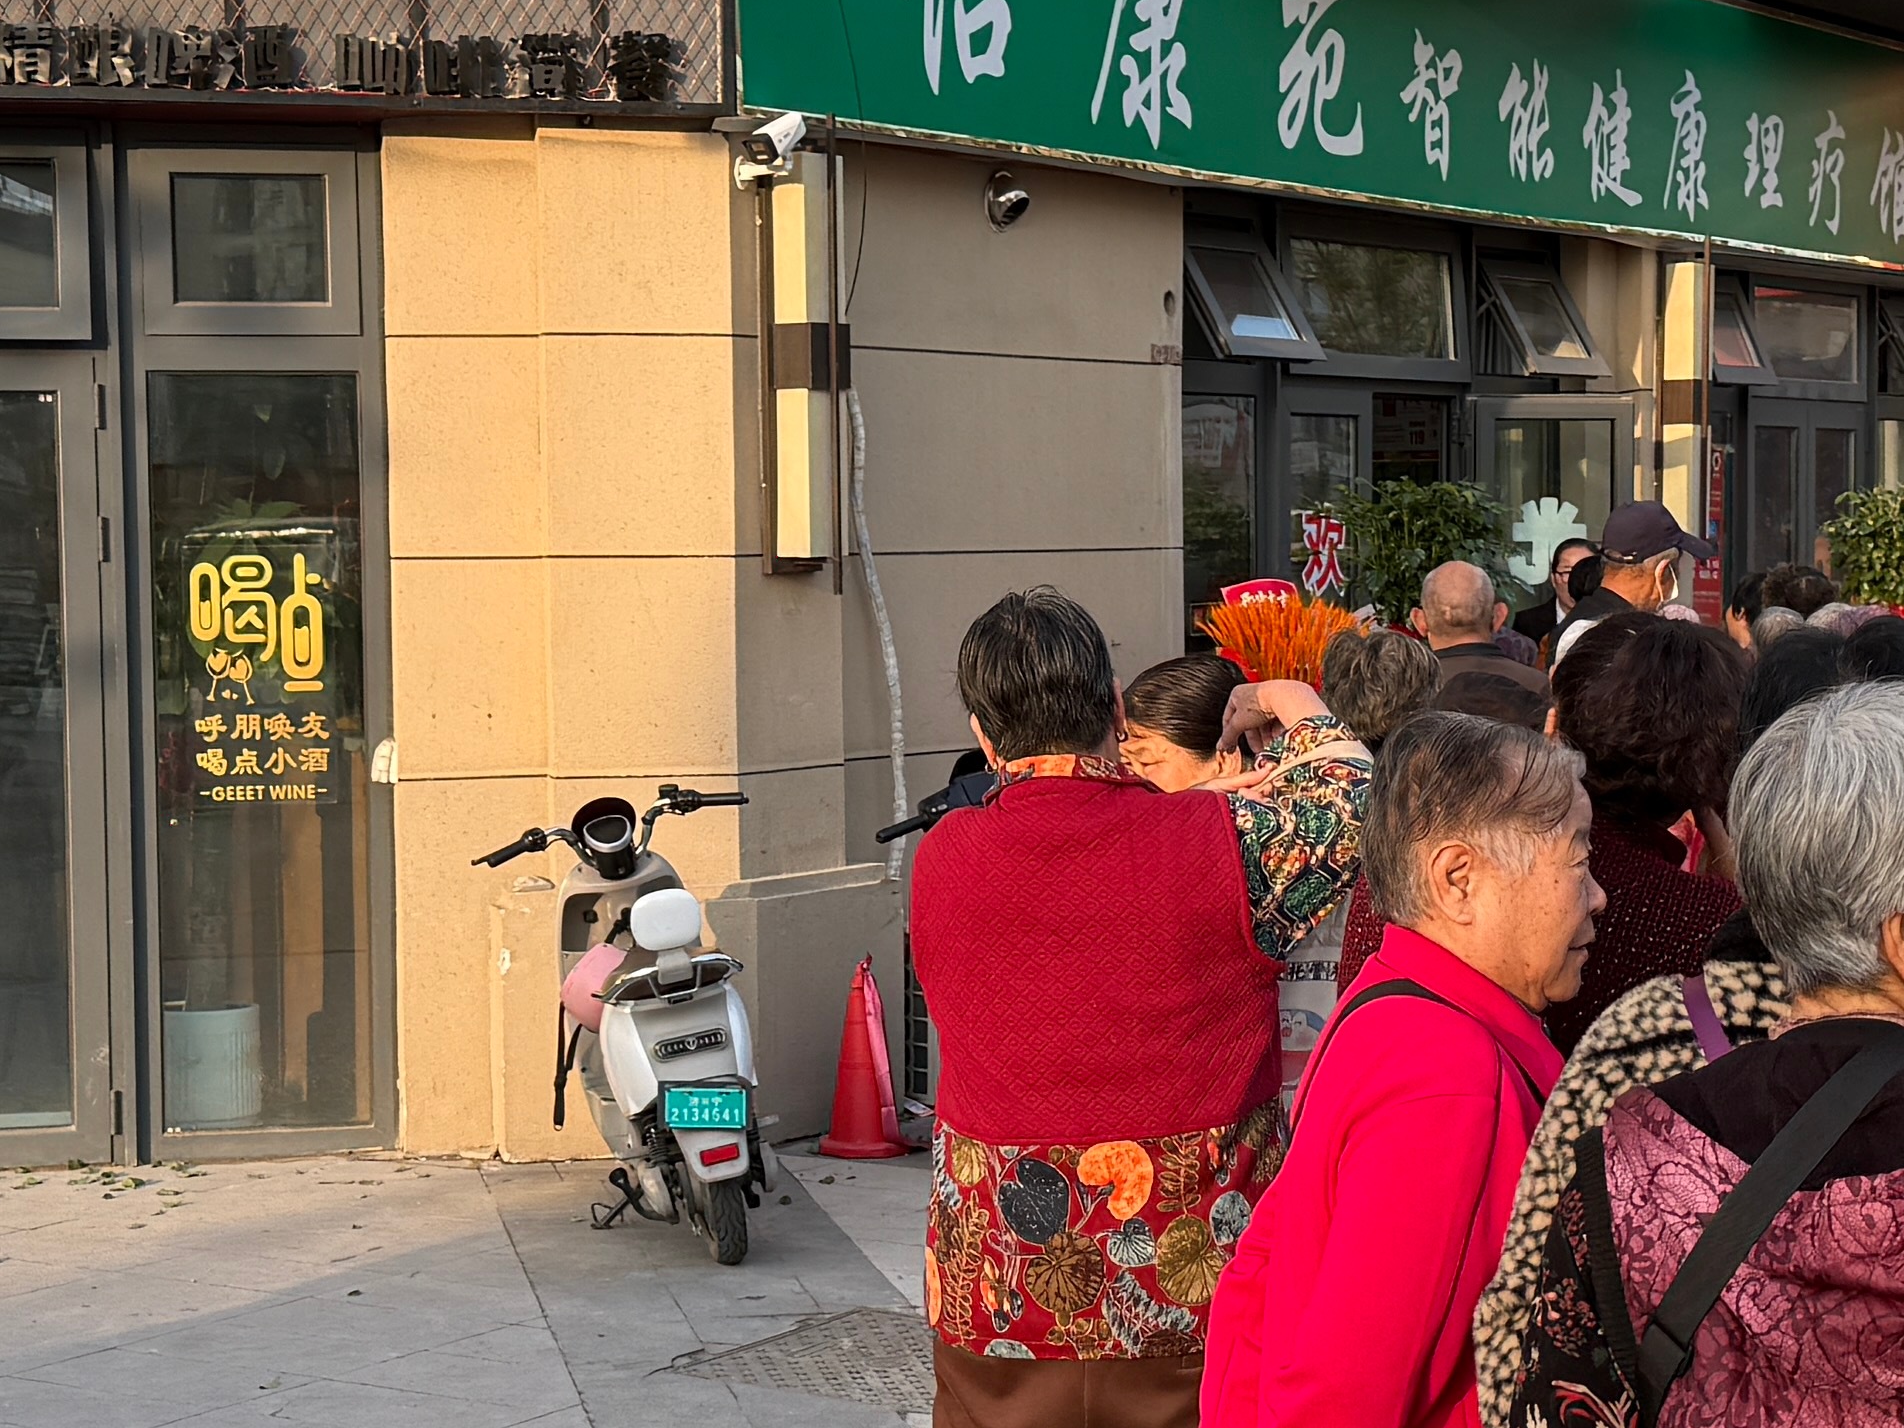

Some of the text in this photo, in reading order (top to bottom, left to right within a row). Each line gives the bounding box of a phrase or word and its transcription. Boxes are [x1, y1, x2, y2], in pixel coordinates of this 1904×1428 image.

[195, 712, 330, 742] 呼朋唤友
[196, 748, 330, 777] 喝点小酒
